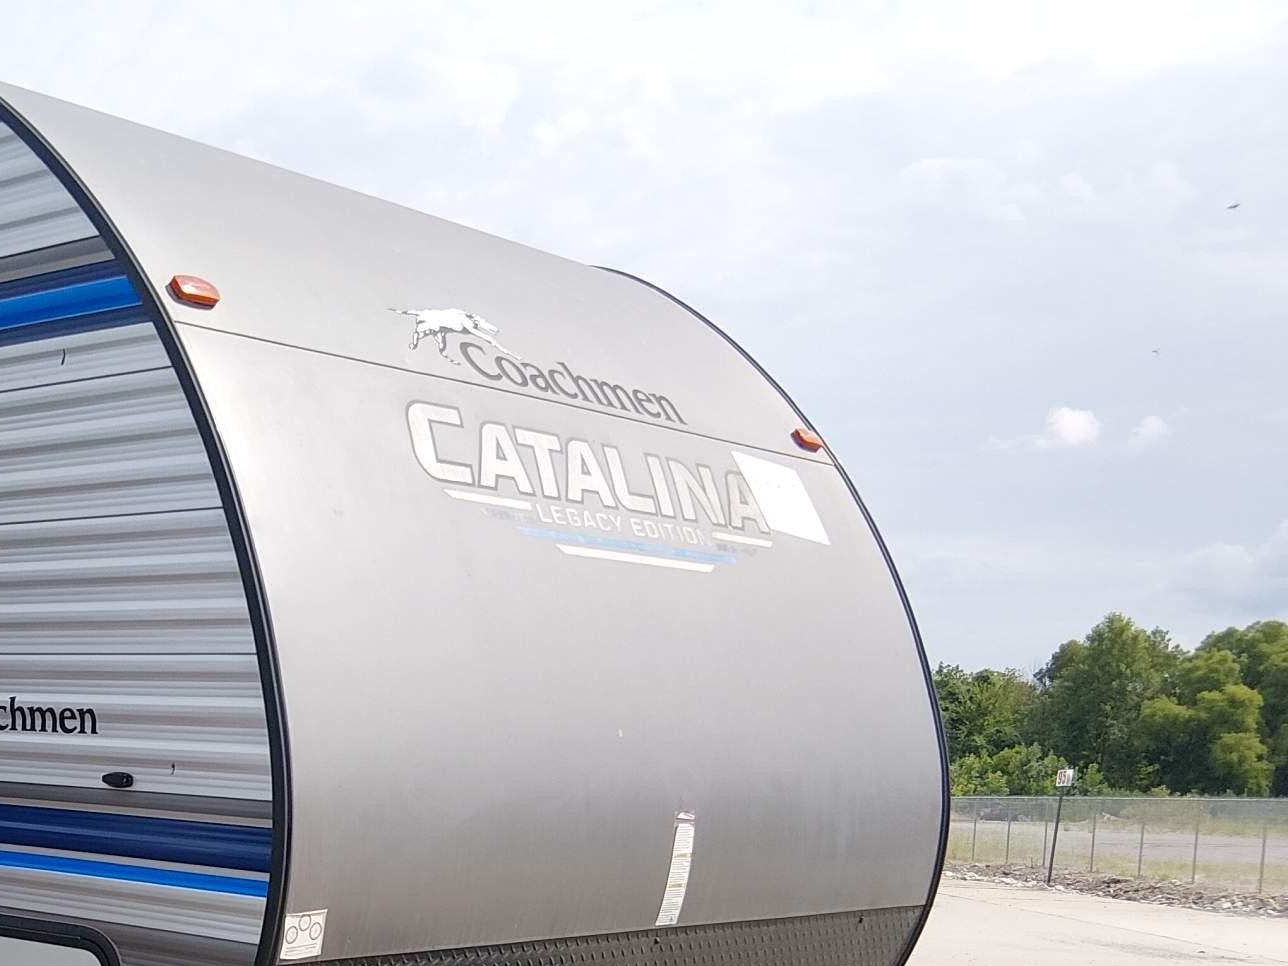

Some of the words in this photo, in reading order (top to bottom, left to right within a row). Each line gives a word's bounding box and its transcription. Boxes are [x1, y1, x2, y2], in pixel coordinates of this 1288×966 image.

[458, 341, 688, 425] Coachmen
[406, 399, 772, 534] CATALINA
[535, 503, 623, 532] LEGACY
